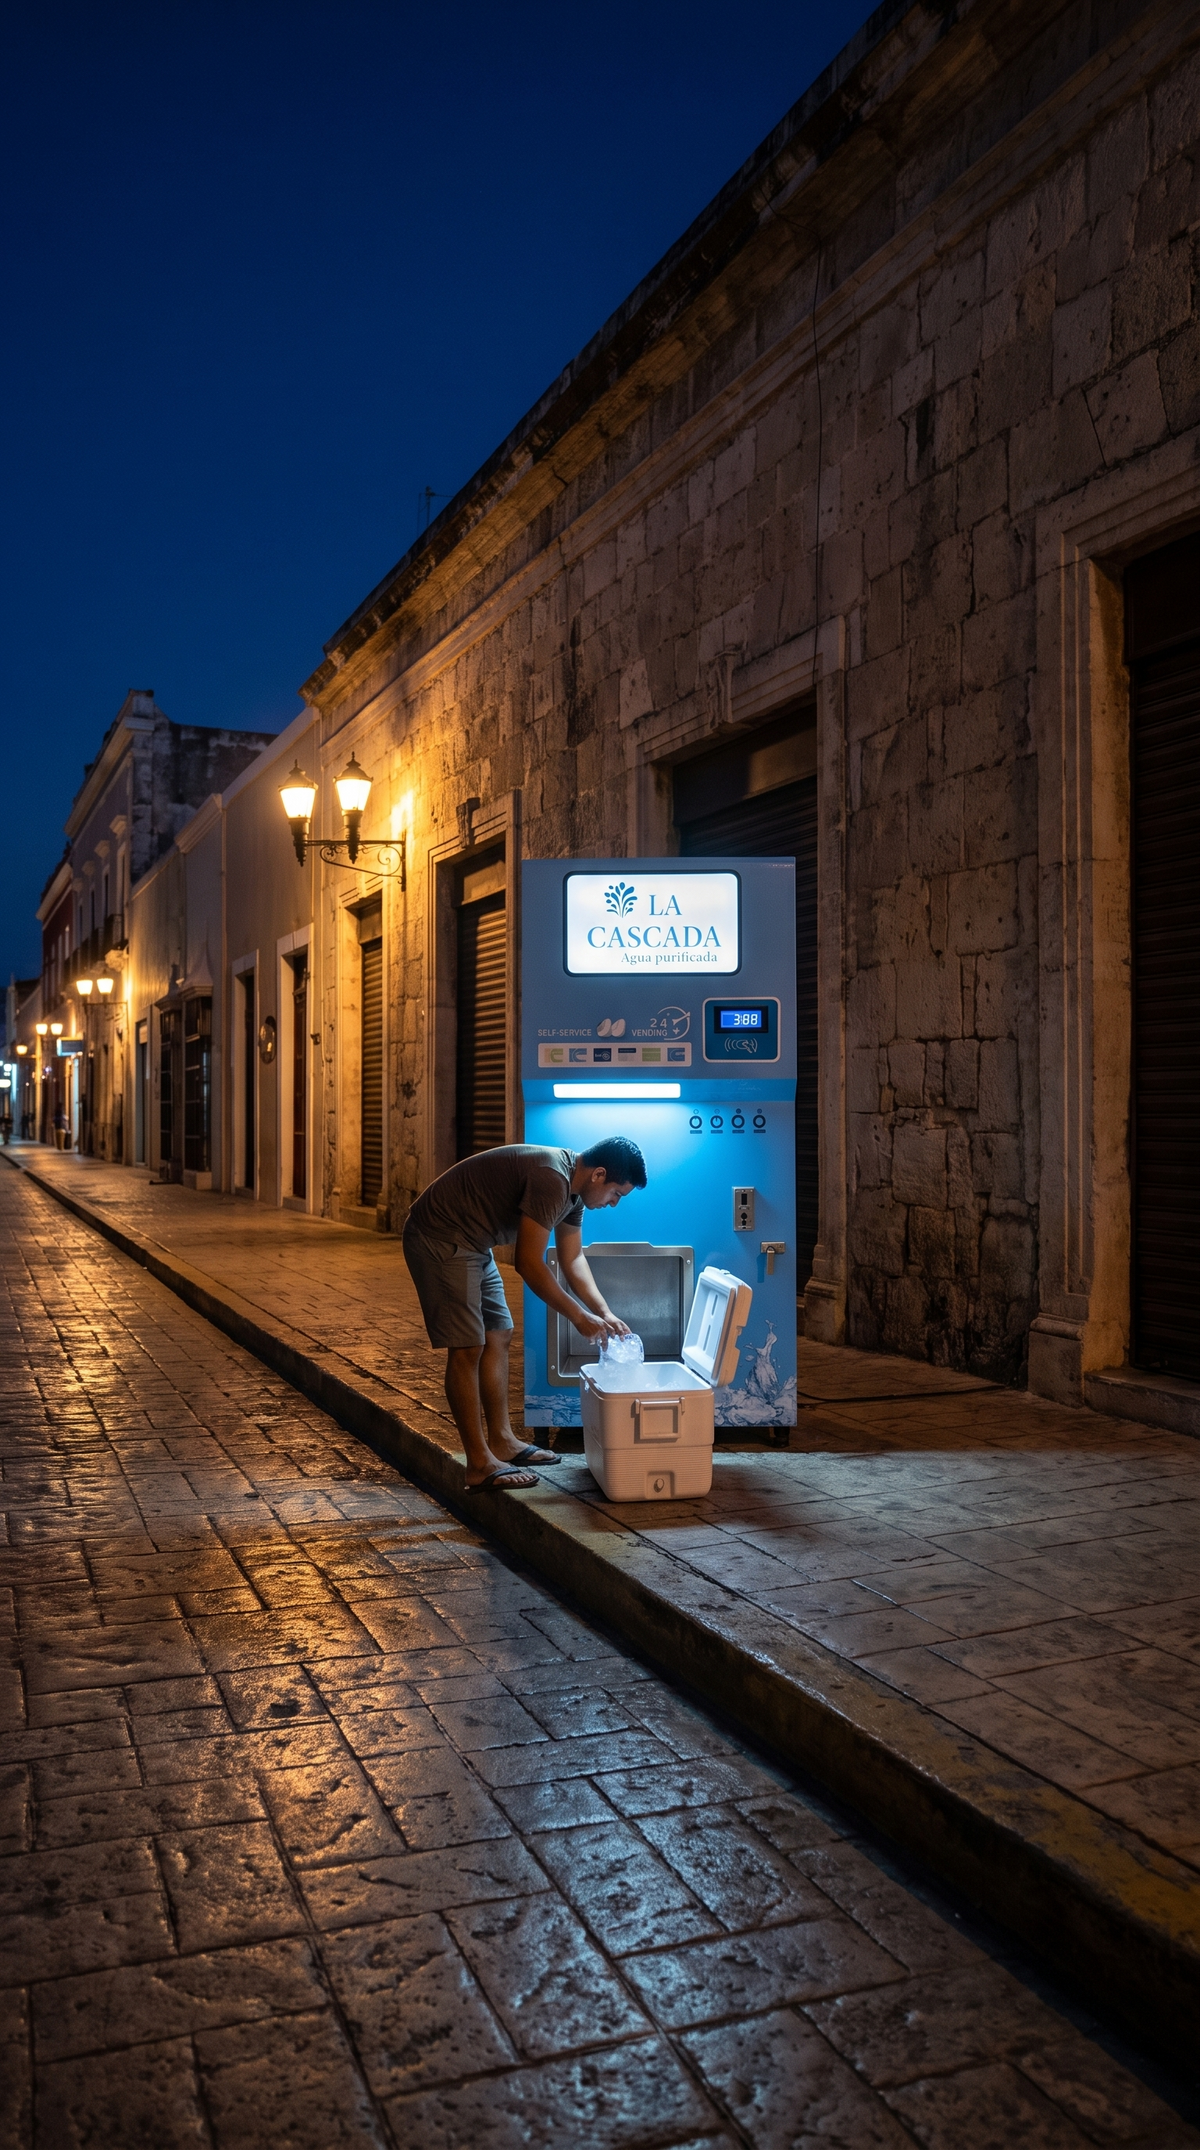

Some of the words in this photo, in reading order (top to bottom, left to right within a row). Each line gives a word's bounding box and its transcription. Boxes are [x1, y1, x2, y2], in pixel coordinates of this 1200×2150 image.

[649, 894, 683, 916] LA
[587, 925, 722, 949] CASCADA
[621, 952, 652, 965] Agua
[655, 952, 718, 965] purificada
[537, 1028, 592, 1037] SELF-SERVICE
[631, 1028, 668, 1037] VENDING
